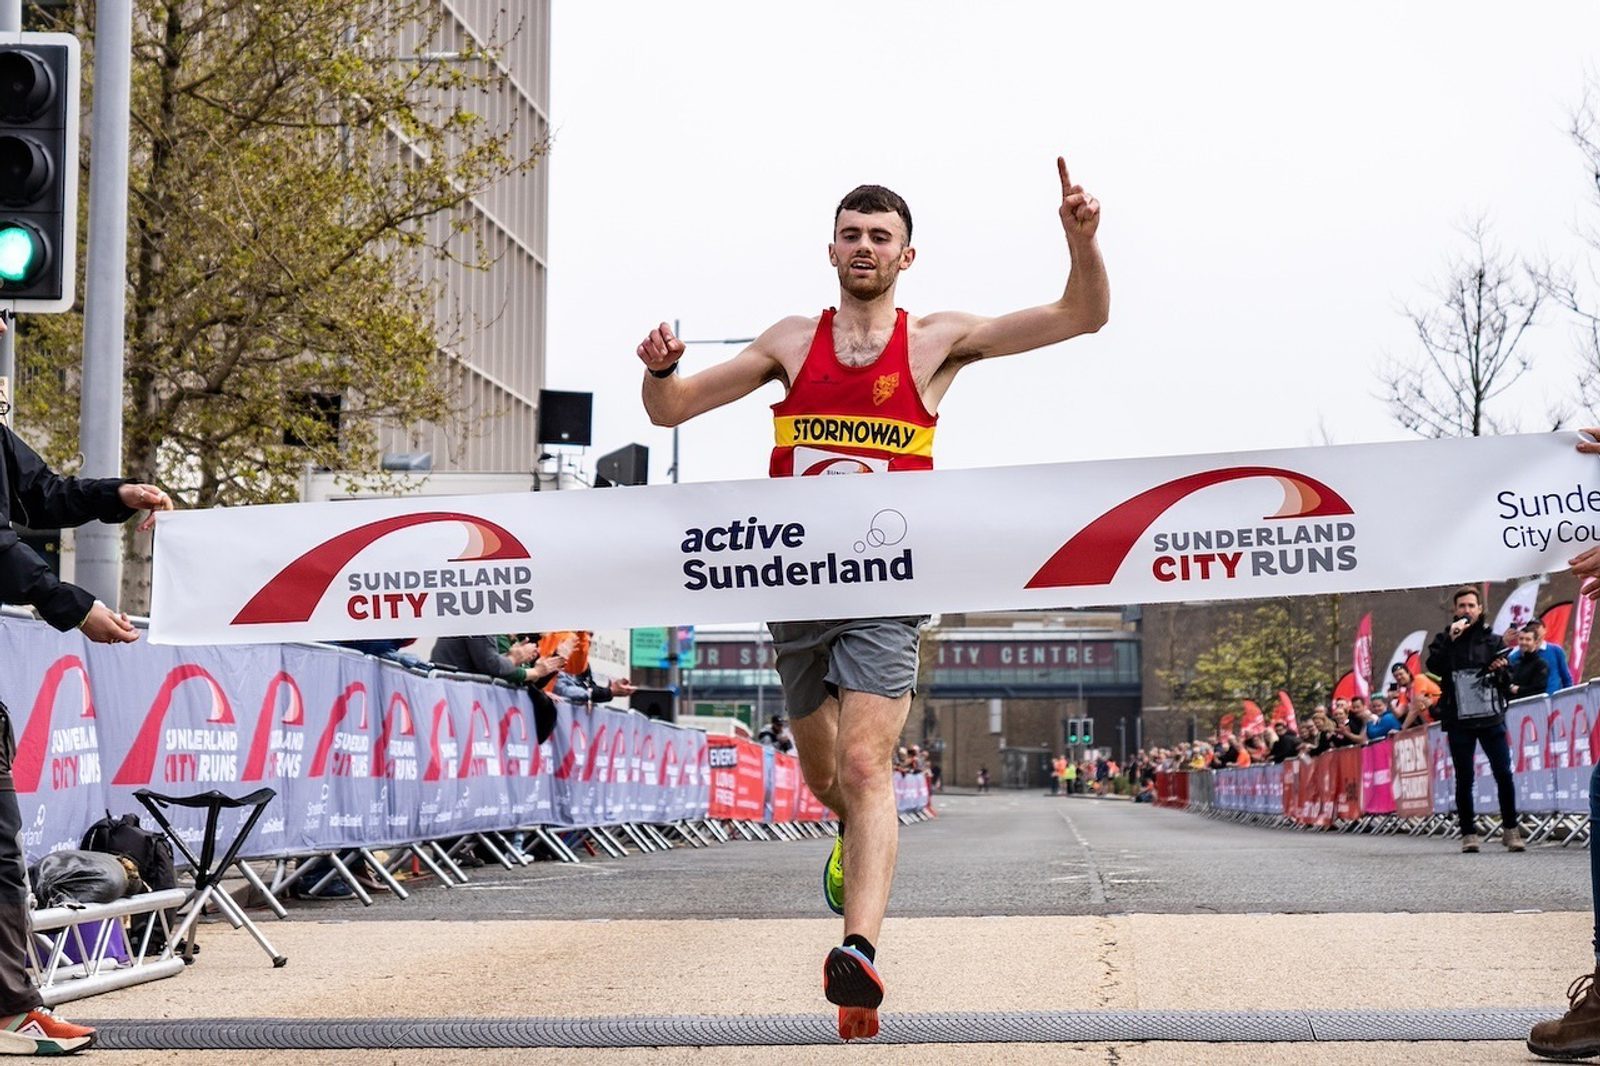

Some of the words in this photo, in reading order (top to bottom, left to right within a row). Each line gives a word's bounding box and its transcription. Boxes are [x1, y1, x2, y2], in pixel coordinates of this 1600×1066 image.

[793, 417, 916, 449] STORNOWAY
[1497, 484, 1600, 519] Sunde
[681, 516, 806, 553] active
[1154, 522, 1356, 551] SUNDERLAND
[1503, 525, 1552, 552] City
[348, 566, 532, 591] SUNDERLAND
[683, 548, 914, 591] Sunderland
[1152, 552, 1244, 582] CITY
[1251, 545, 1358, 576] RUNS
[347, 592, 429, 620] CITY
[435, 588, 535, 617] RUNS
[1000, 646, 1094, 664] CENTRE
[197, 753, 238, 782] RUNS
